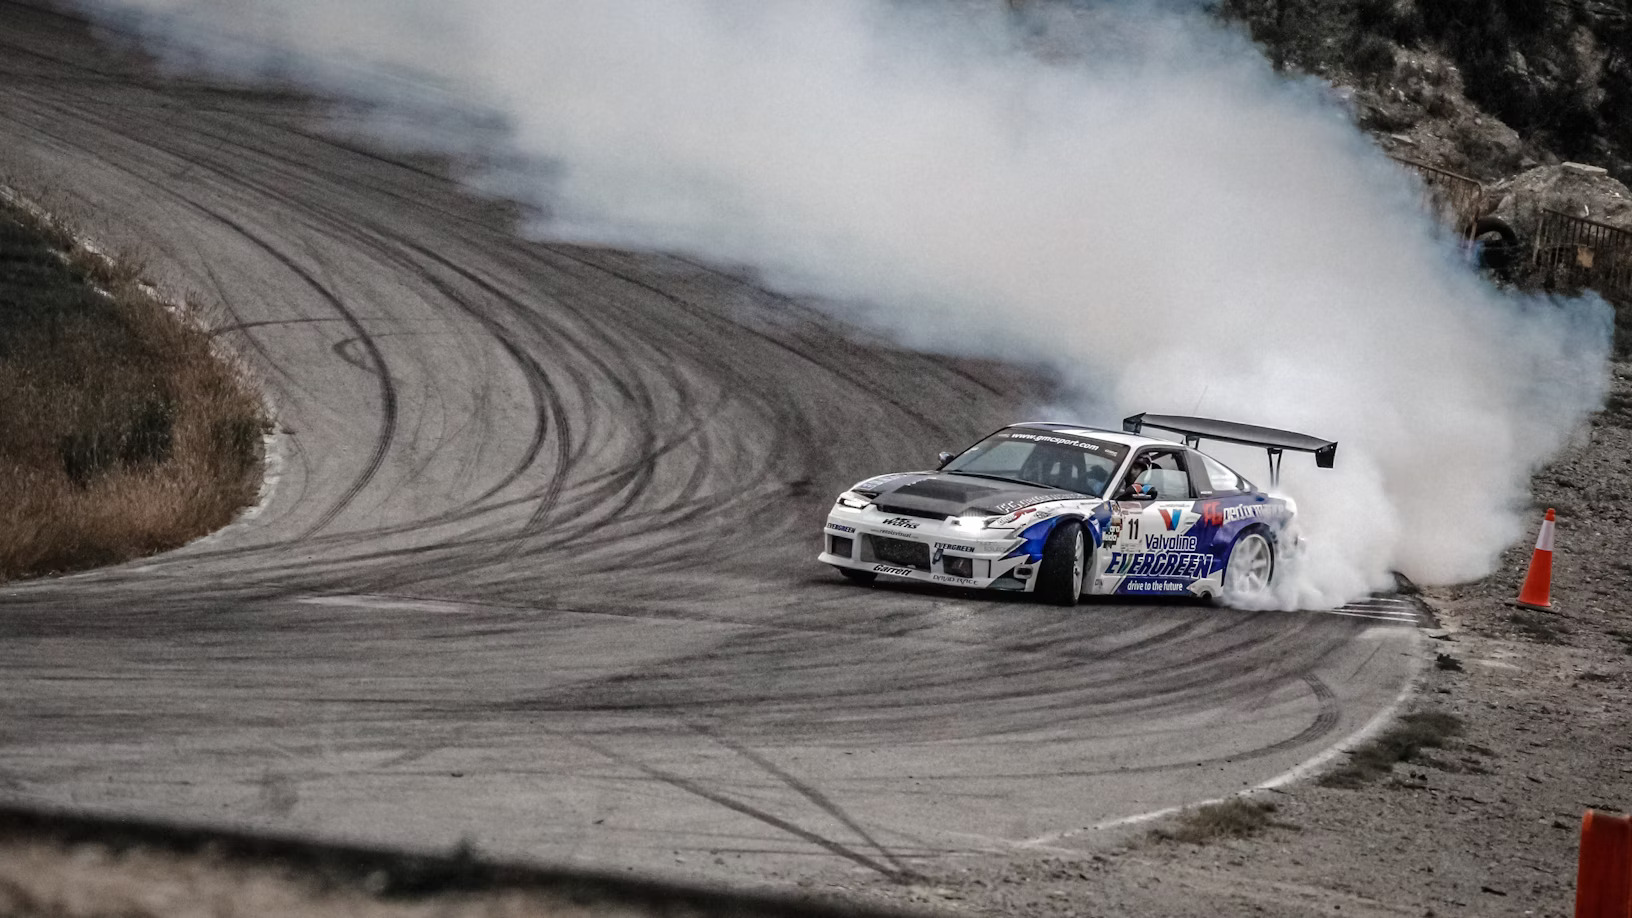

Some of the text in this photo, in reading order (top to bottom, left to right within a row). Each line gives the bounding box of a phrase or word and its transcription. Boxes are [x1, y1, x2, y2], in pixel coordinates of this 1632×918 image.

[1011, 433, 1100, 451] www.gmcsport.com
[1223, 503, 1285, 523] perform
[1128, 518, 1139, 540] 11
[934, 541, 975, 553] EVERGREEN
[1145, 533, 1197, 551] Valvoline
[873, 564, 912, 577] Garrett
[1104, 551, 1214, 579] EVERGREEN
[1127, 580, 1183, 592] drive to the future
